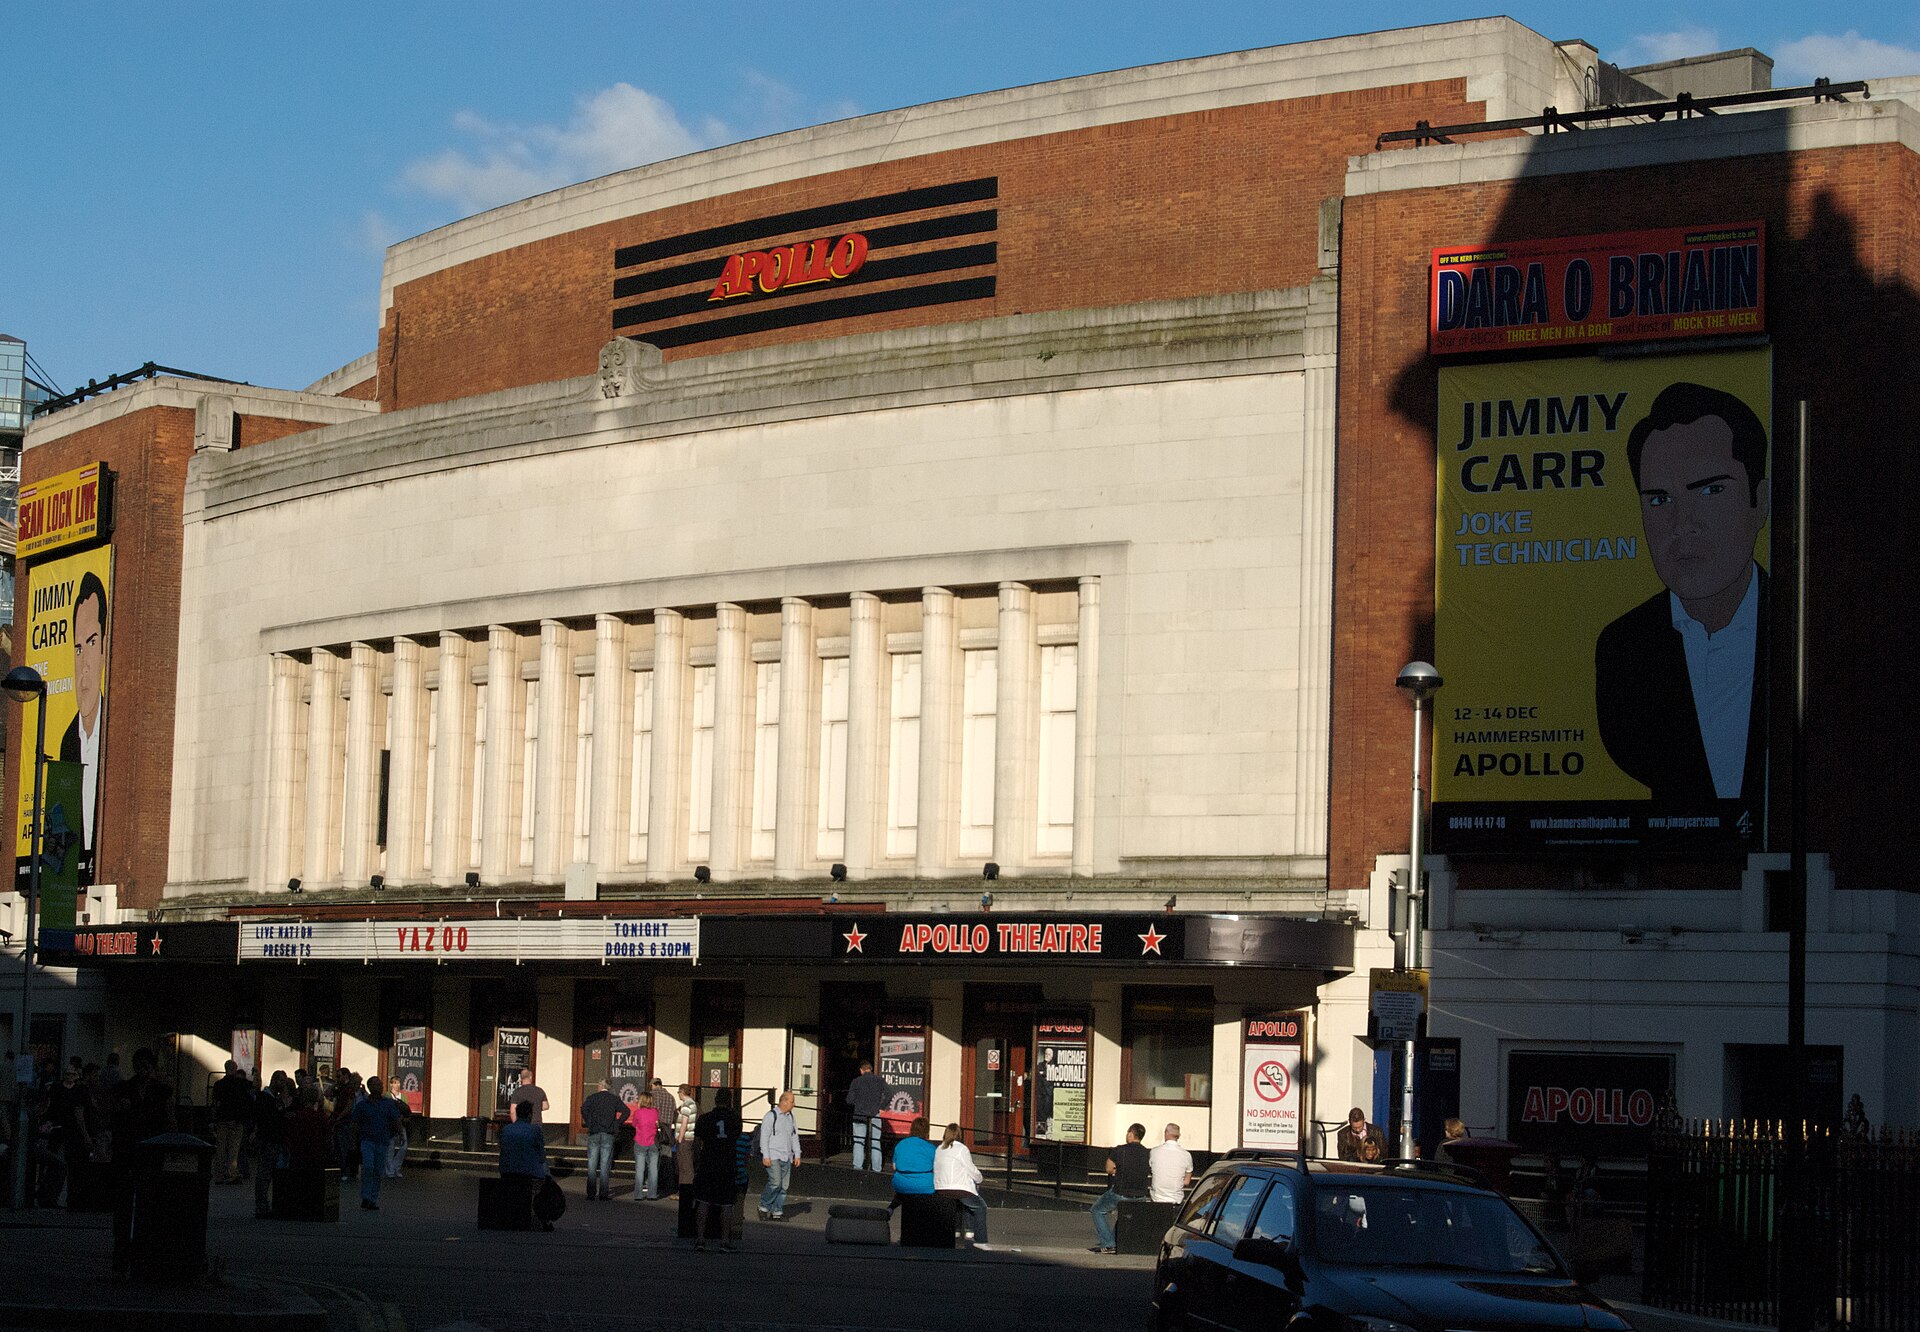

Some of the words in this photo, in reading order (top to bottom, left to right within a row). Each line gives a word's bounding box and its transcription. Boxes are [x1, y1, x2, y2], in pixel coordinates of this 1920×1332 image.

[707, 232, 869, 302] APOLLO
[1437, 262, 1549, 331] DARA
[1563, 257, 1593, 322] O
[1608, 243, 1758, 319] BRIAIN
[1506, 329, 1537, 343] THREE
[1540, 327, 1562, 341] MEN
[1565, 326, 1575, 339] IN
[1578, 325, 1585, 337] A
[1587, 322, 1613, 338] BOAT
[1673, 317, 1704, 331] MOCK
[1706, 314, 1725, 328] THE
[1728, 312, 1758, 327] WEEK
[1456, 391, 1628, 451] JIMMY
[1460, 450, 1607, 493] CARR
[19, 498, 44, 542] SEAN
[46, 488, 73, 533] LOCK
[75, 481, 97, 525] LIVE
[1455, 509, 1532, 536] JOKE
[1455, 536, 1637, 566] TECHNICIAN
[32, 580, 74, 622] JIMMY
[32, 619, 67, 650] CARR
[1506, 706, 1538, 719] DEC
[1454, 729, 1584, 743] HAMMERSMITH
[1454, 752, 1584, 777] APOLLO
[1648, 815, 1720, 831] www.jimmycarr.com
[256, 926, 274, 939] LIVE
[278, 925, 312, 939] NATION
[397, 926, 468, 952] YAZOO
[614, 922, 669, 937] TONIGHT
[899, 923, 990, 953] APOLLO
[997, 923, 1102, 953] THEATRE
[96, 931, 138, 955] THEATRE
[263, 943, 311, 957] PRESENTS
[606, 941, 644, 957] DOORS
[500, 1032, 530, 1046] Yazoo
[1248, 1020, 1297, 1038] APOLLO
[397, 1045, 425, 1058] LEAGUE
[611, 1054, 645, 1068] LEAGUE
[1057, 1049, 1087, 1065] MICHAEL
[881, 1060, 924, 1075] LEAGUE
[1247, 1109, 1258, 1118] NO
[1259, 1109, 1297, 1119] SMOKING.
[1521, 1086, 1654, 1125] APOLLO
[715, 1120, 728, 1139] 1
